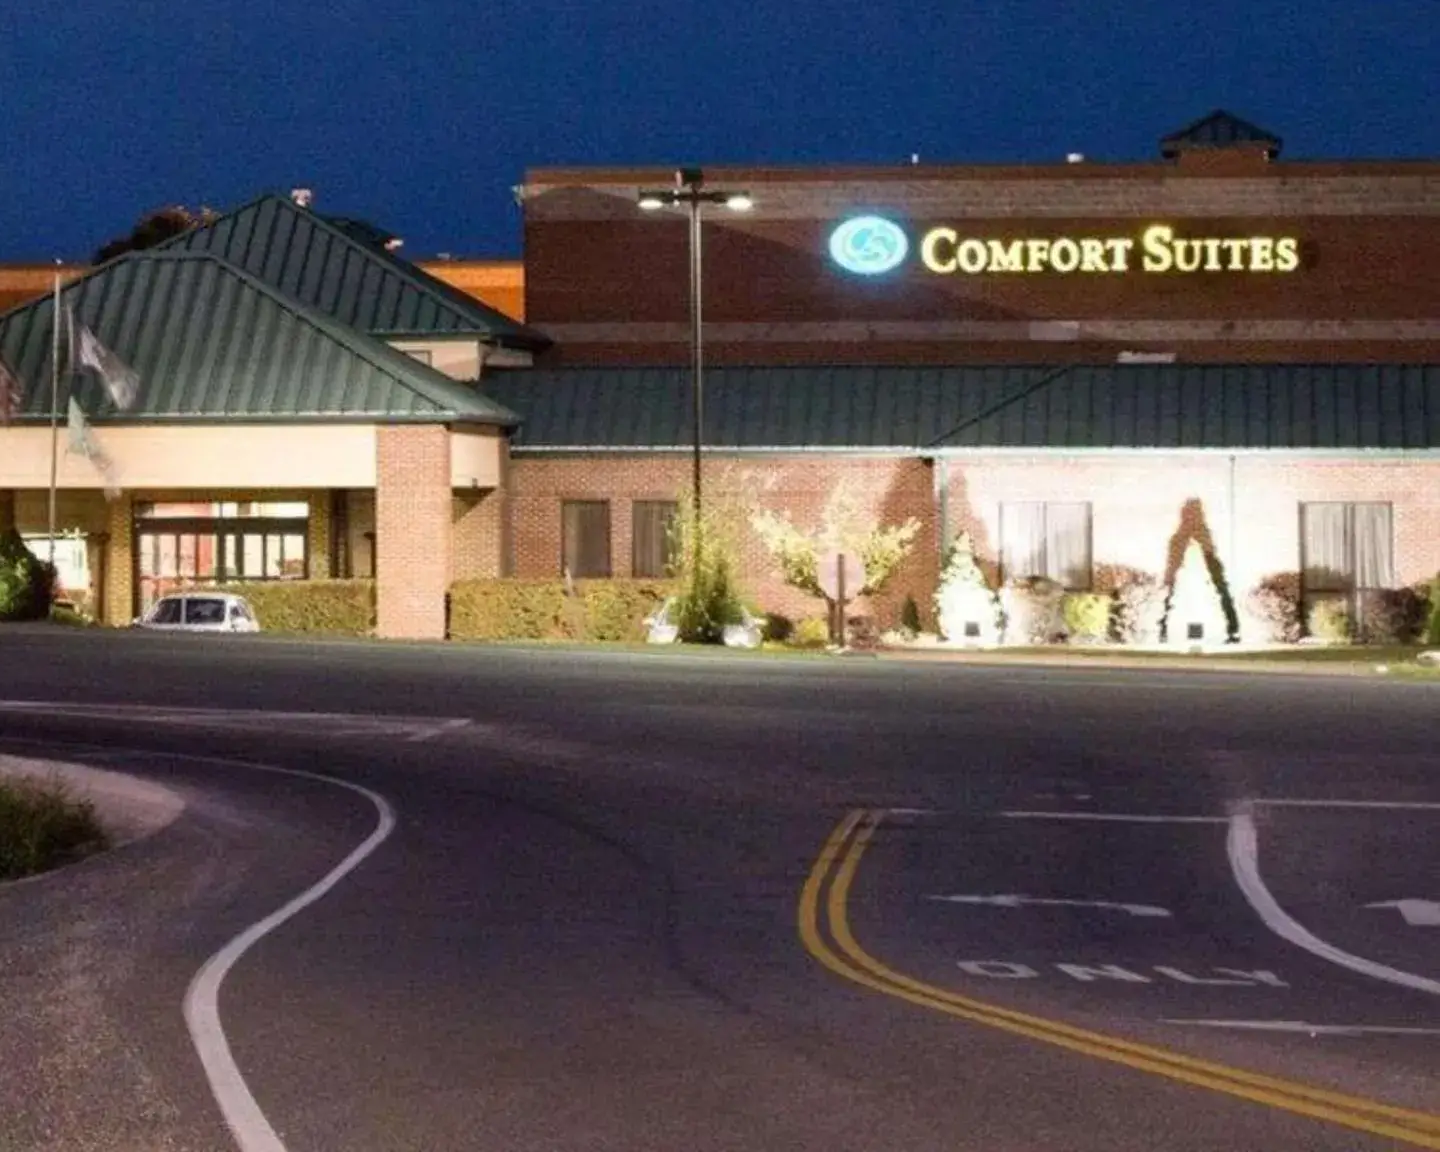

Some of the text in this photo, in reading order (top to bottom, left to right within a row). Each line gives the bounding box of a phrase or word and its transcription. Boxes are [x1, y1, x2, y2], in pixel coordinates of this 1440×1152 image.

[920, 224, 1301, 274] COMFORT SUITES
[956, 958, 1292, 989] ONLY
